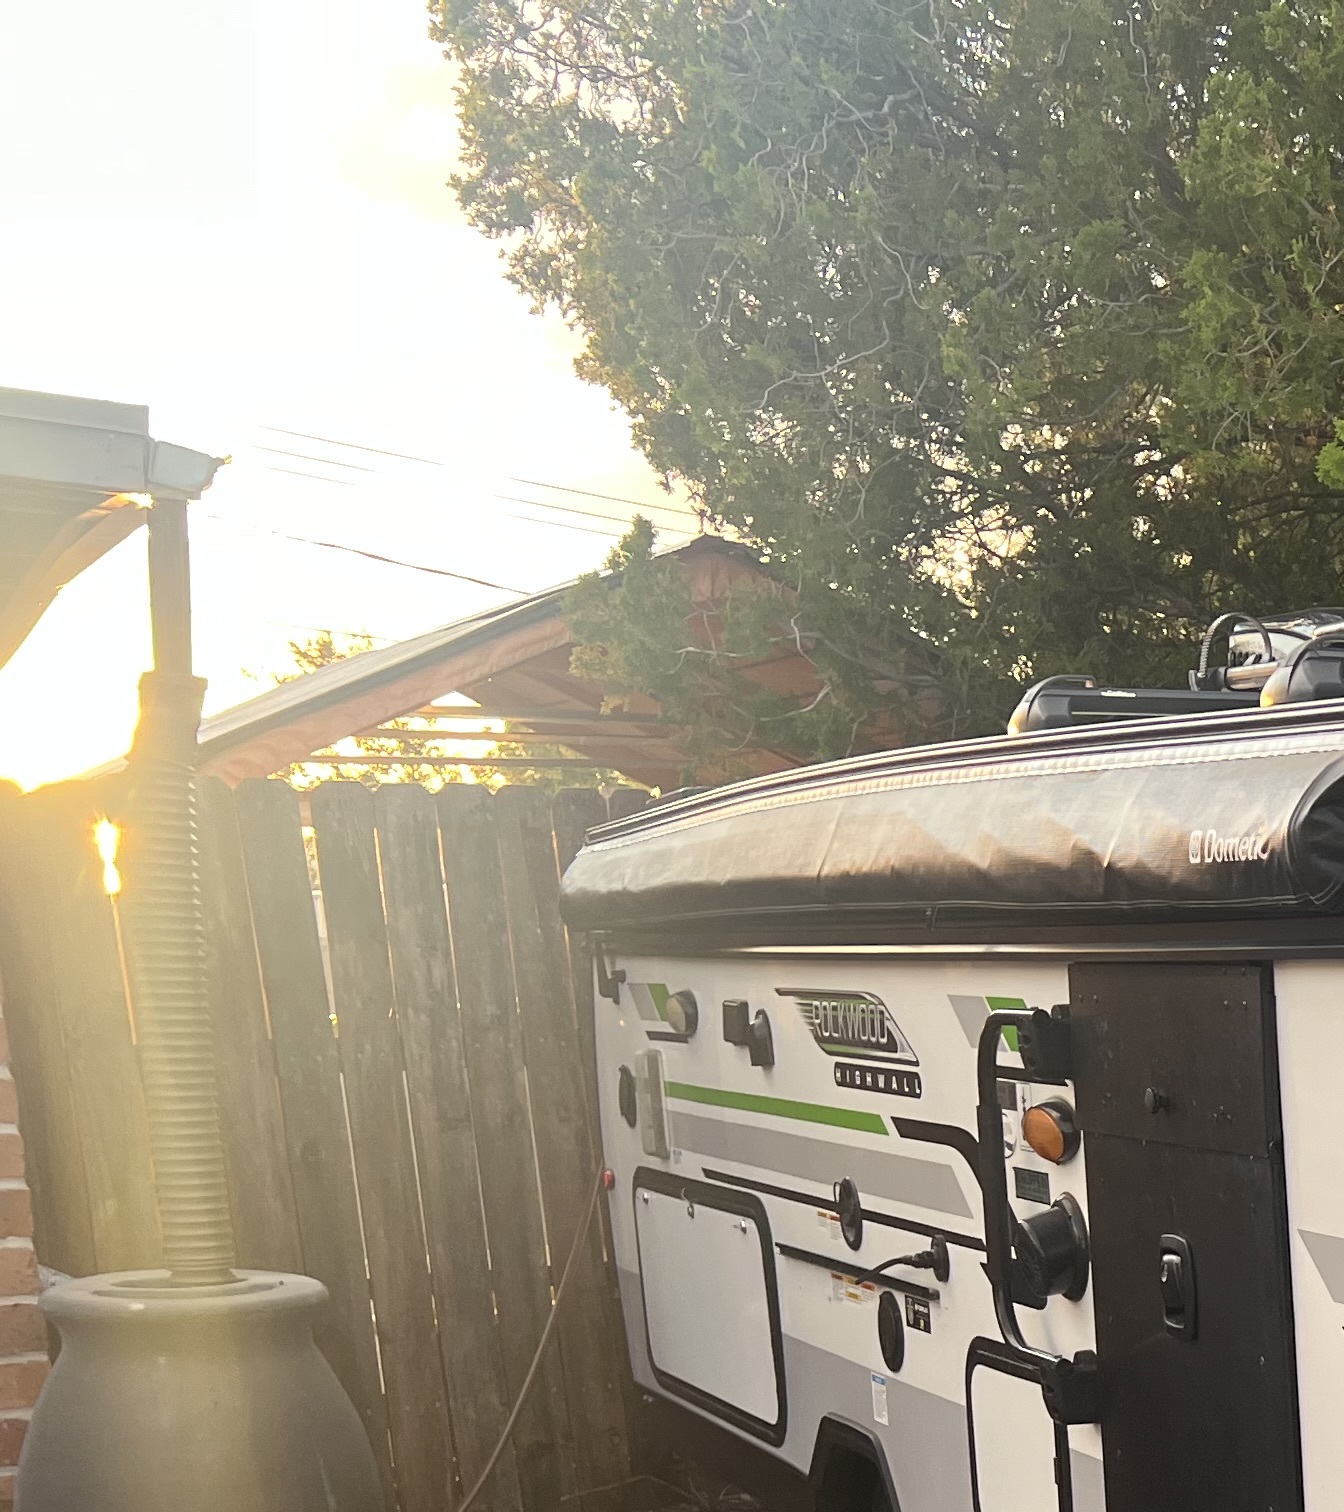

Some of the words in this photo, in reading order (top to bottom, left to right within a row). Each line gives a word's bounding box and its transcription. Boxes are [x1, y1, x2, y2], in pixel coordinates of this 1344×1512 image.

[1204, 828, 1270, 863] Dometic
[812, 1000, 888, 1044] ROCKWOOD
[835, 1067, 921, 1094] HIGHWALL
